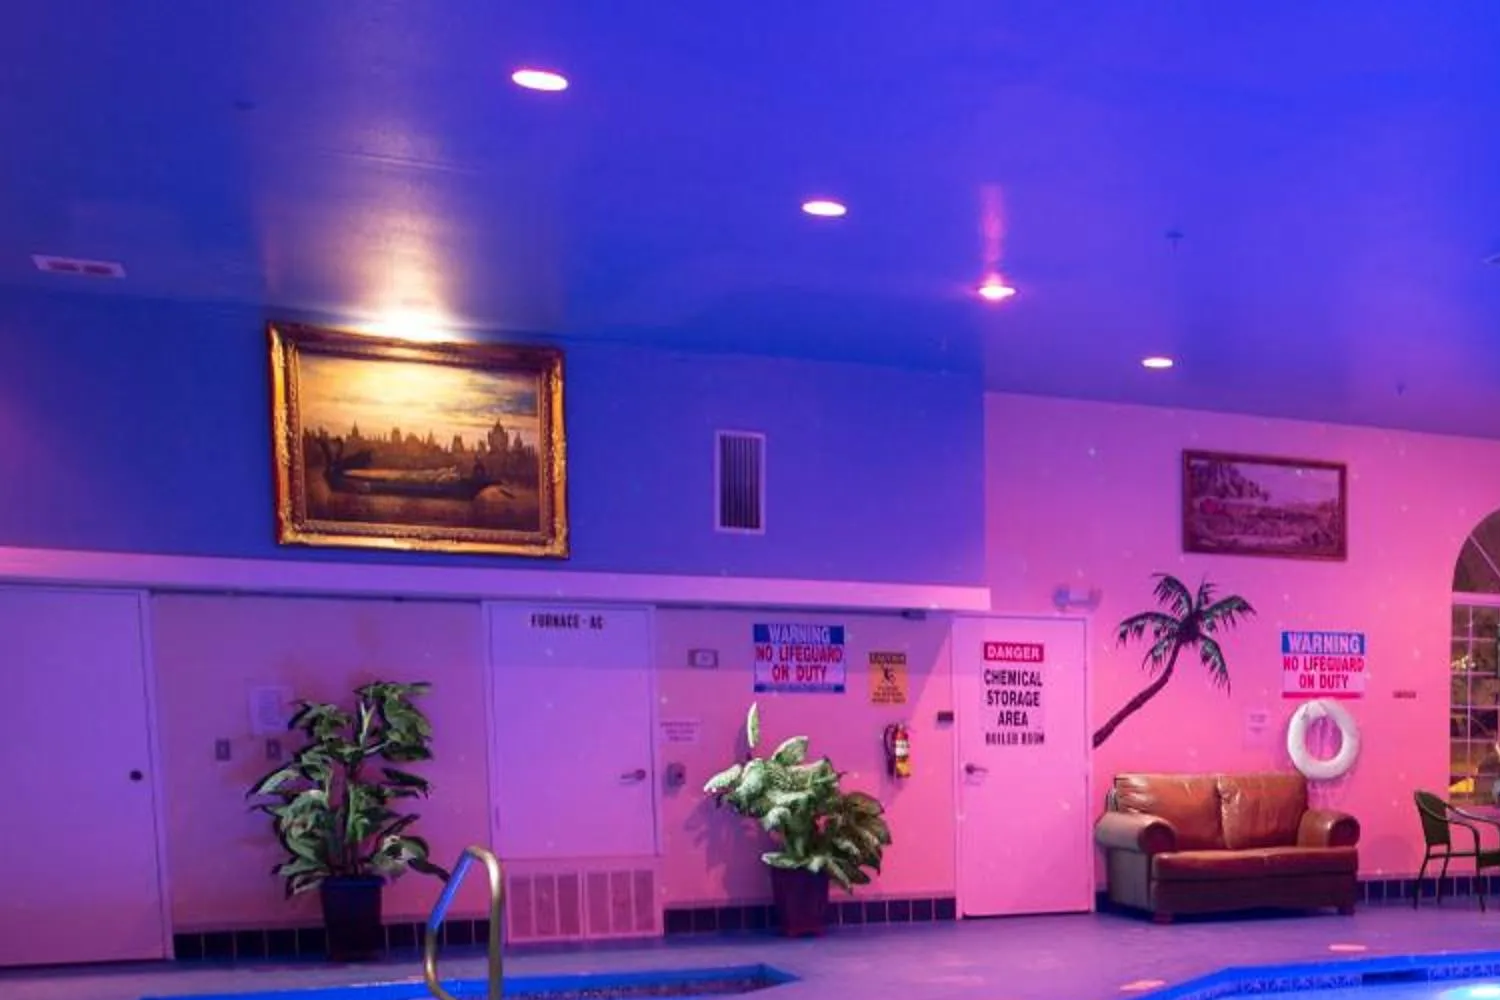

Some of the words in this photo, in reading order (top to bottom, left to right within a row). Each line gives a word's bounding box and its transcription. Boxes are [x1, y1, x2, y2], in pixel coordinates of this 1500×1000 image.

[1287, 632, 1360, 653] WARNING
[756, 645, 772, 662] NO
[987, 645, 1040, 660] DANGER
[1283, 656, 1298, 671] NO
[1303, 656, 1364, 672] LIFEGUARD
[772, 665, 788, 681] ON
[796, 665, 826, 683] DUTY
[984, 668, 1042, 687] CHEMICAL
[1299, 674, 1314, 688] ON
[1320, 674, 1349, 689] DUTY
[987, 689, 1040, 706] STORAGE
[998, 710, 1028, 726] AREA
